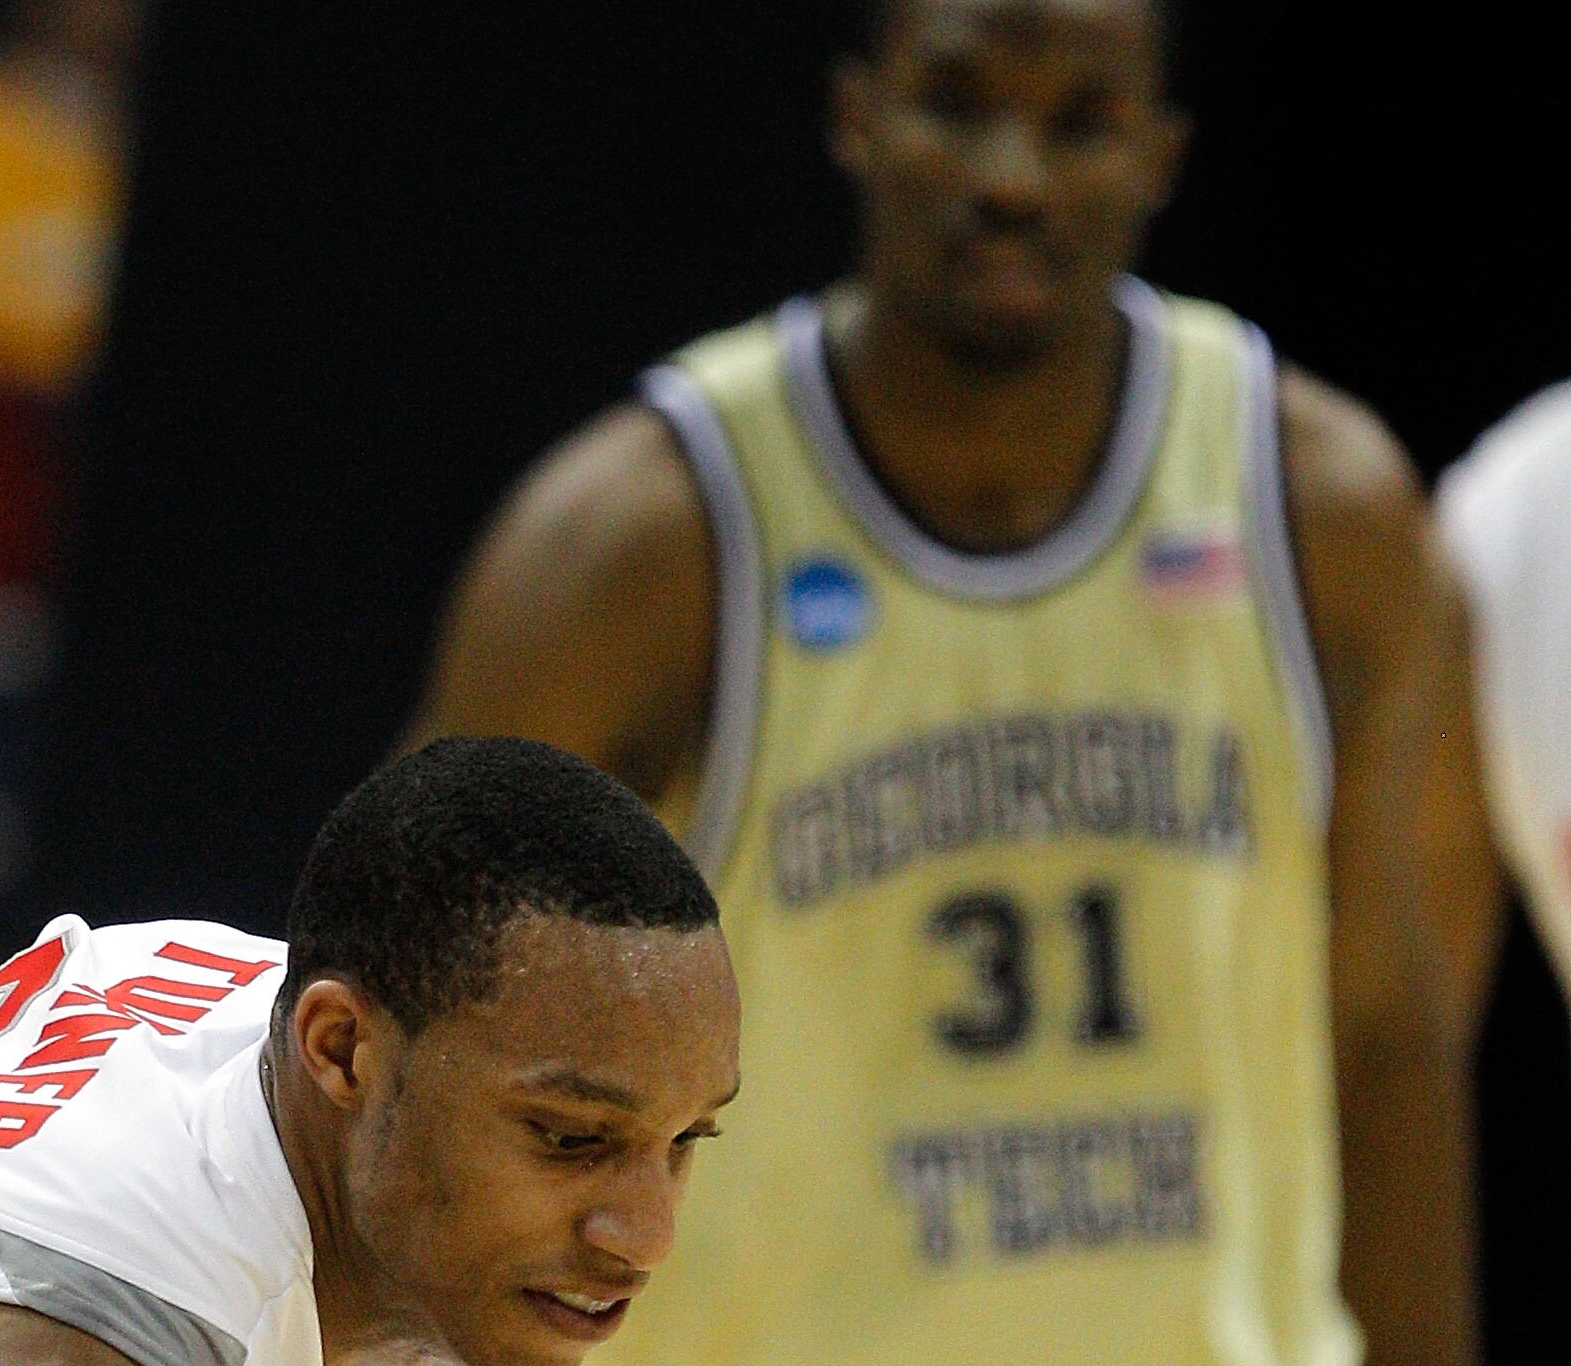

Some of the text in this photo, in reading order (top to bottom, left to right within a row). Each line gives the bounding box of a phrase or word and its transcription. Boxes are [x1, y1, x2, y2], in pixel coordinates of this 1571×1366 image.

[770, 710, 1252, 908] GEORGIA
[929, 882, 1144, 1054] 31
[891, 1114, 1206, 1267] TECH
